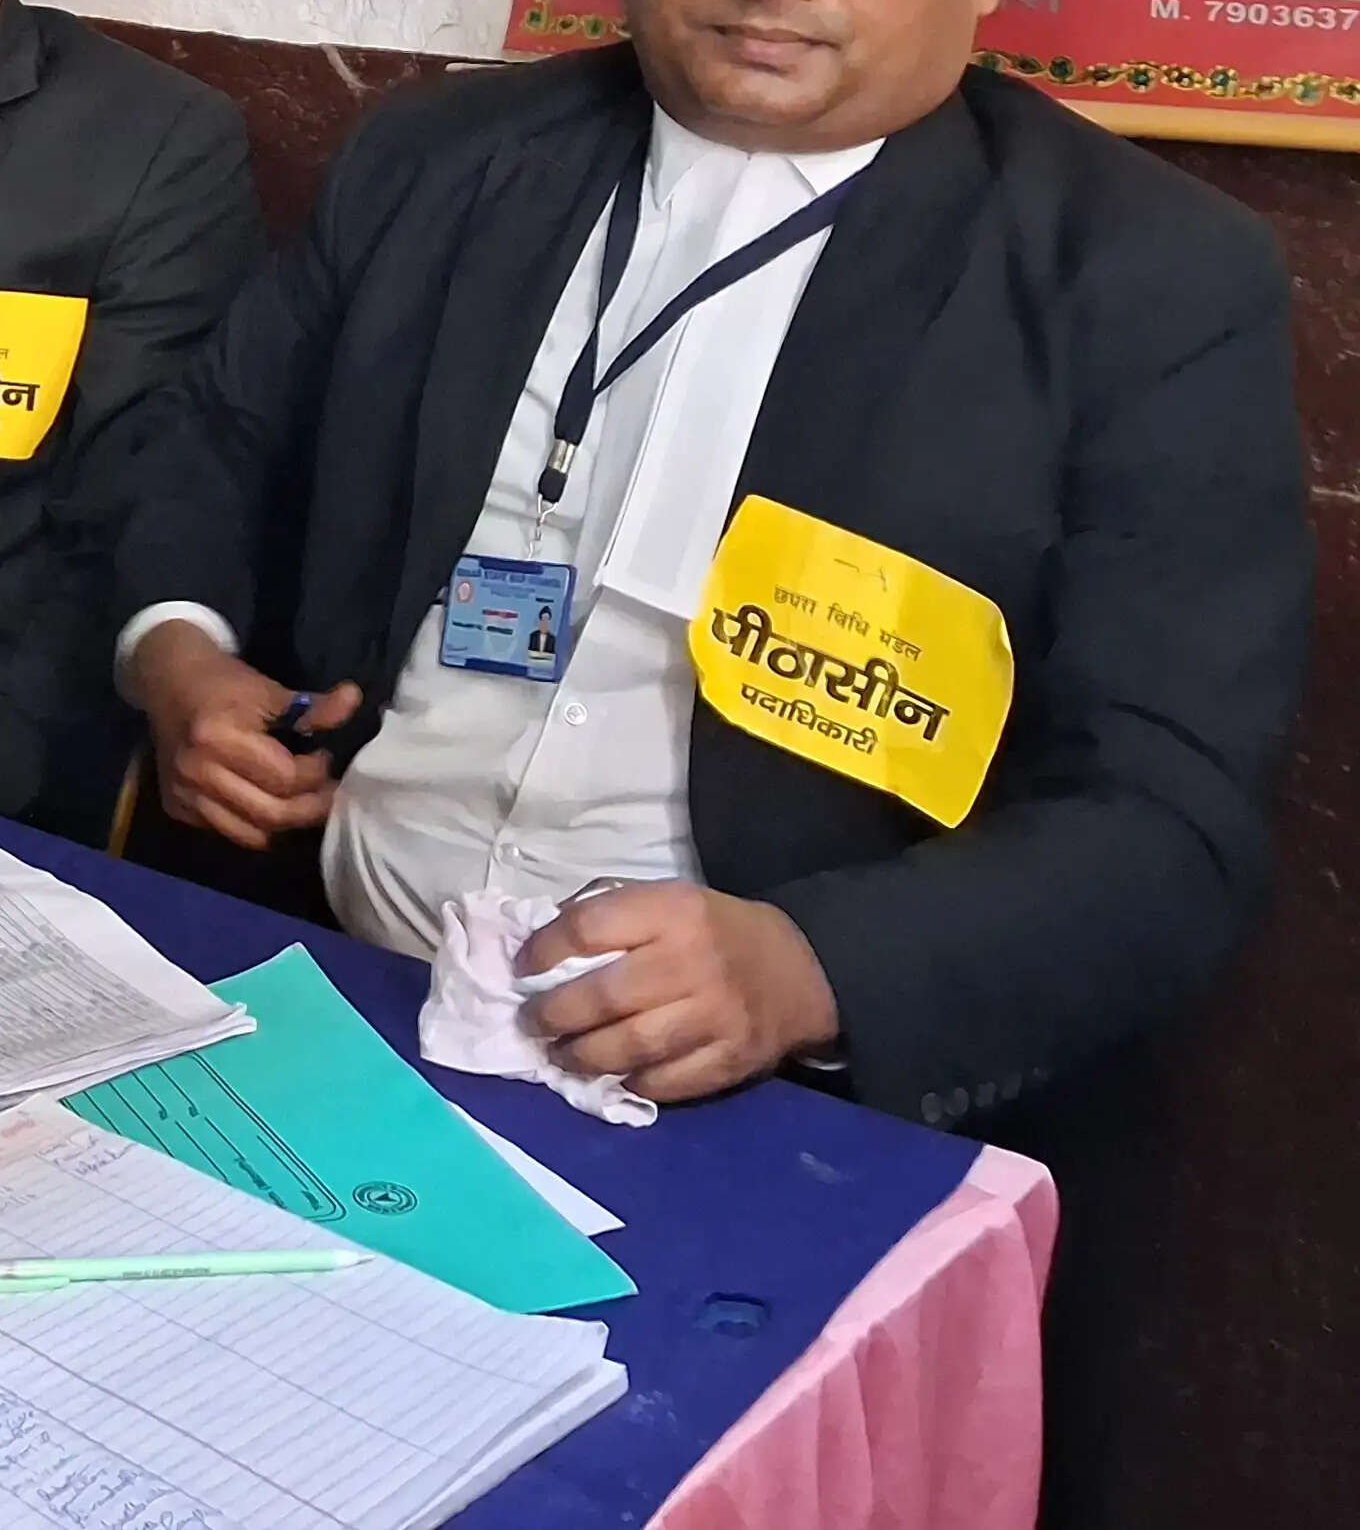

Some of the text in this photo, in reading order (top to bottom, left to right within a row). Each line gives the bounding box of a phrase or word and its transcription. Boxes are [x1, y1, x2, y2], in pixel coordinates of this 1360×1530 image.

[1205, 0, 1360, 31] 7903637
[774, 585, 923, 663] छपरा विधि मंडल
[711, 604, 952, 742] पीठासीन
[740, 681, 880, 756] पदाधिकारी
